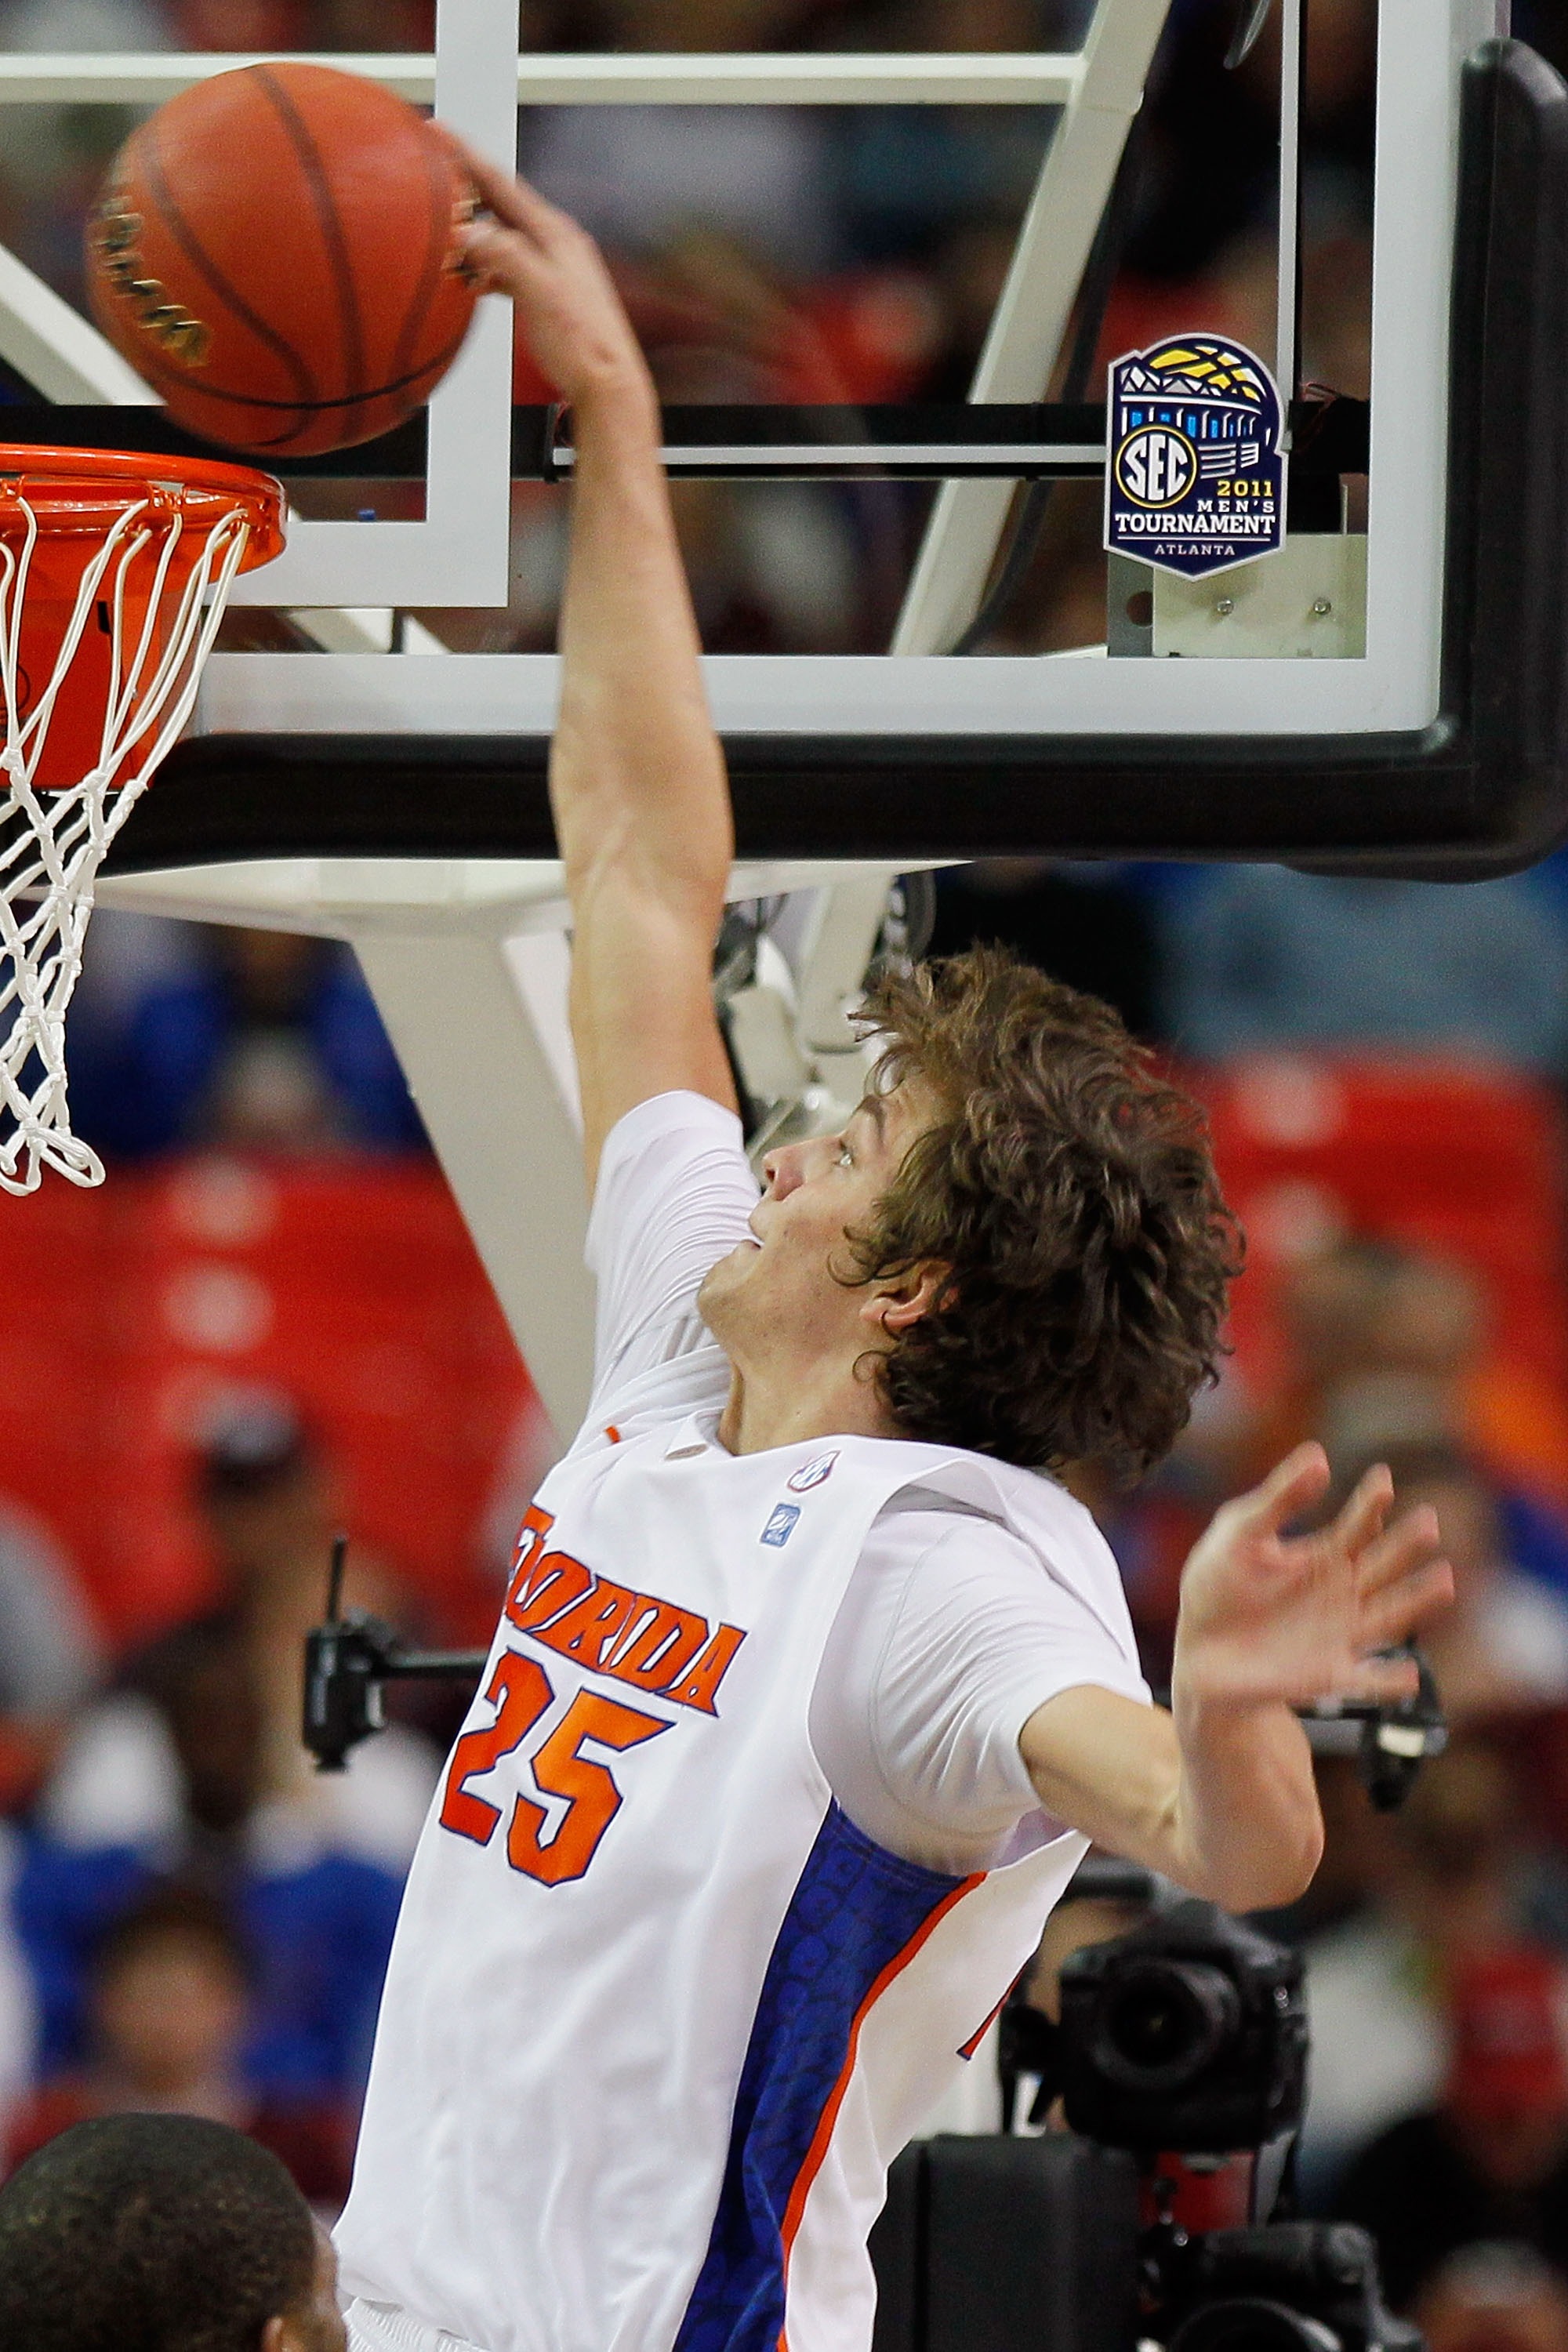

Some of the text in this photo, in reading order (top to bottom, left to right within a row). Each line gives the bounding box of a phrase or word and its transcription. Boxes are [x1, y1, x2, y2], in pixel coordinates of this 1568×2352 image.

[1124, 434, 1189, 501] SEC
[1217, 481, 1273, 497] 2011
[1197, 500, 1275, 513] MEN'S
[1115, 514, 1276, 534] TOURNAMENT
[1154, 544, 1236, 556] ATLANTA
[439, 1647, 676, 1888] 25
